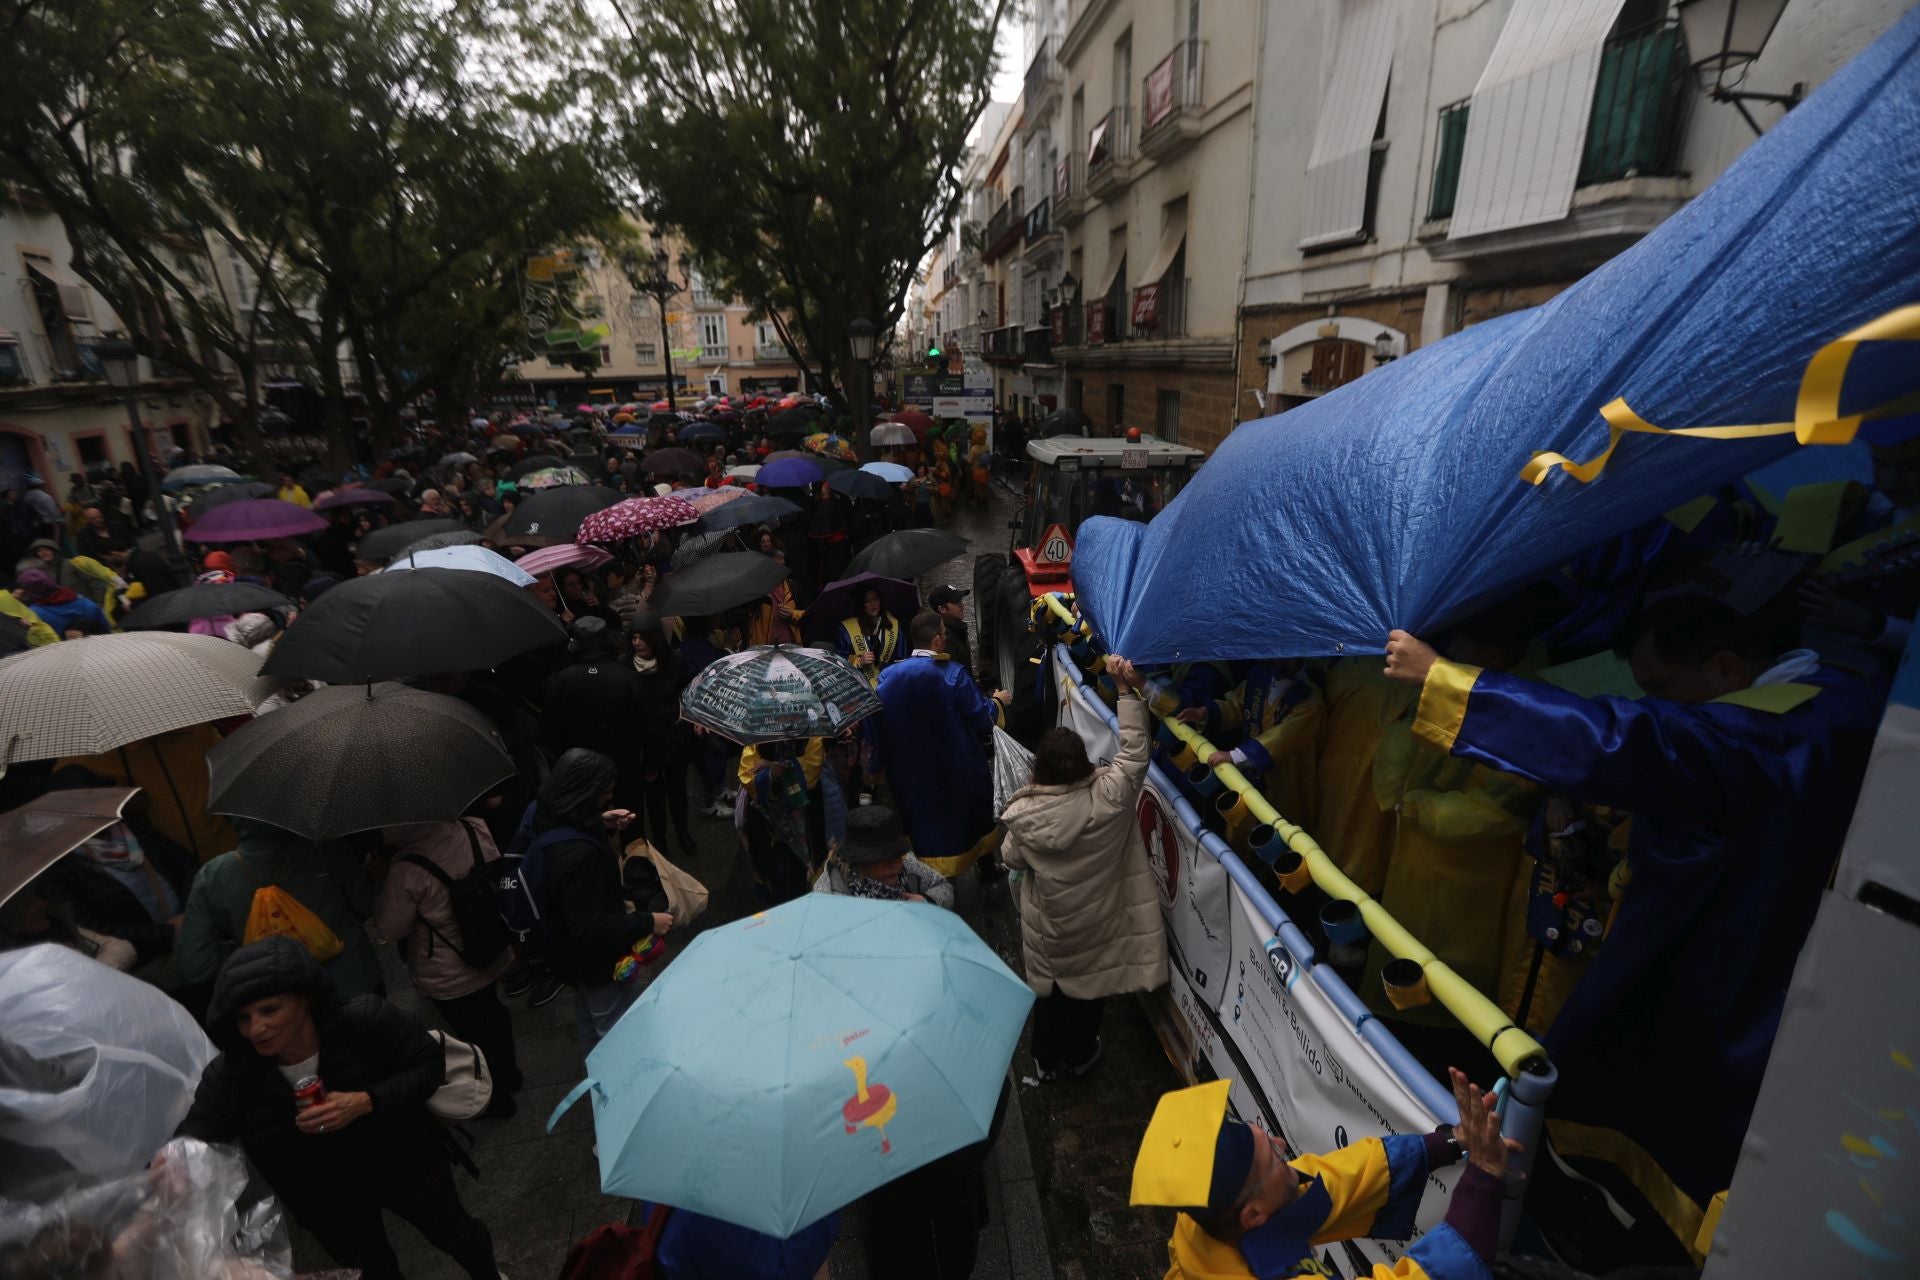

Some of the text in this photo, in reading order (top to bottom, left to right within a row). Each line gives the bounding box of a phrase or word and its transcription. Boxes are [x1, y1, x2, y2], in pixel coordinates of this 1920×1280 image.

[1047, 540, 1065, 560] 40
[854, 634, 866, 652] CORO
[1290, 1011, 1322, 1075] Bellido
